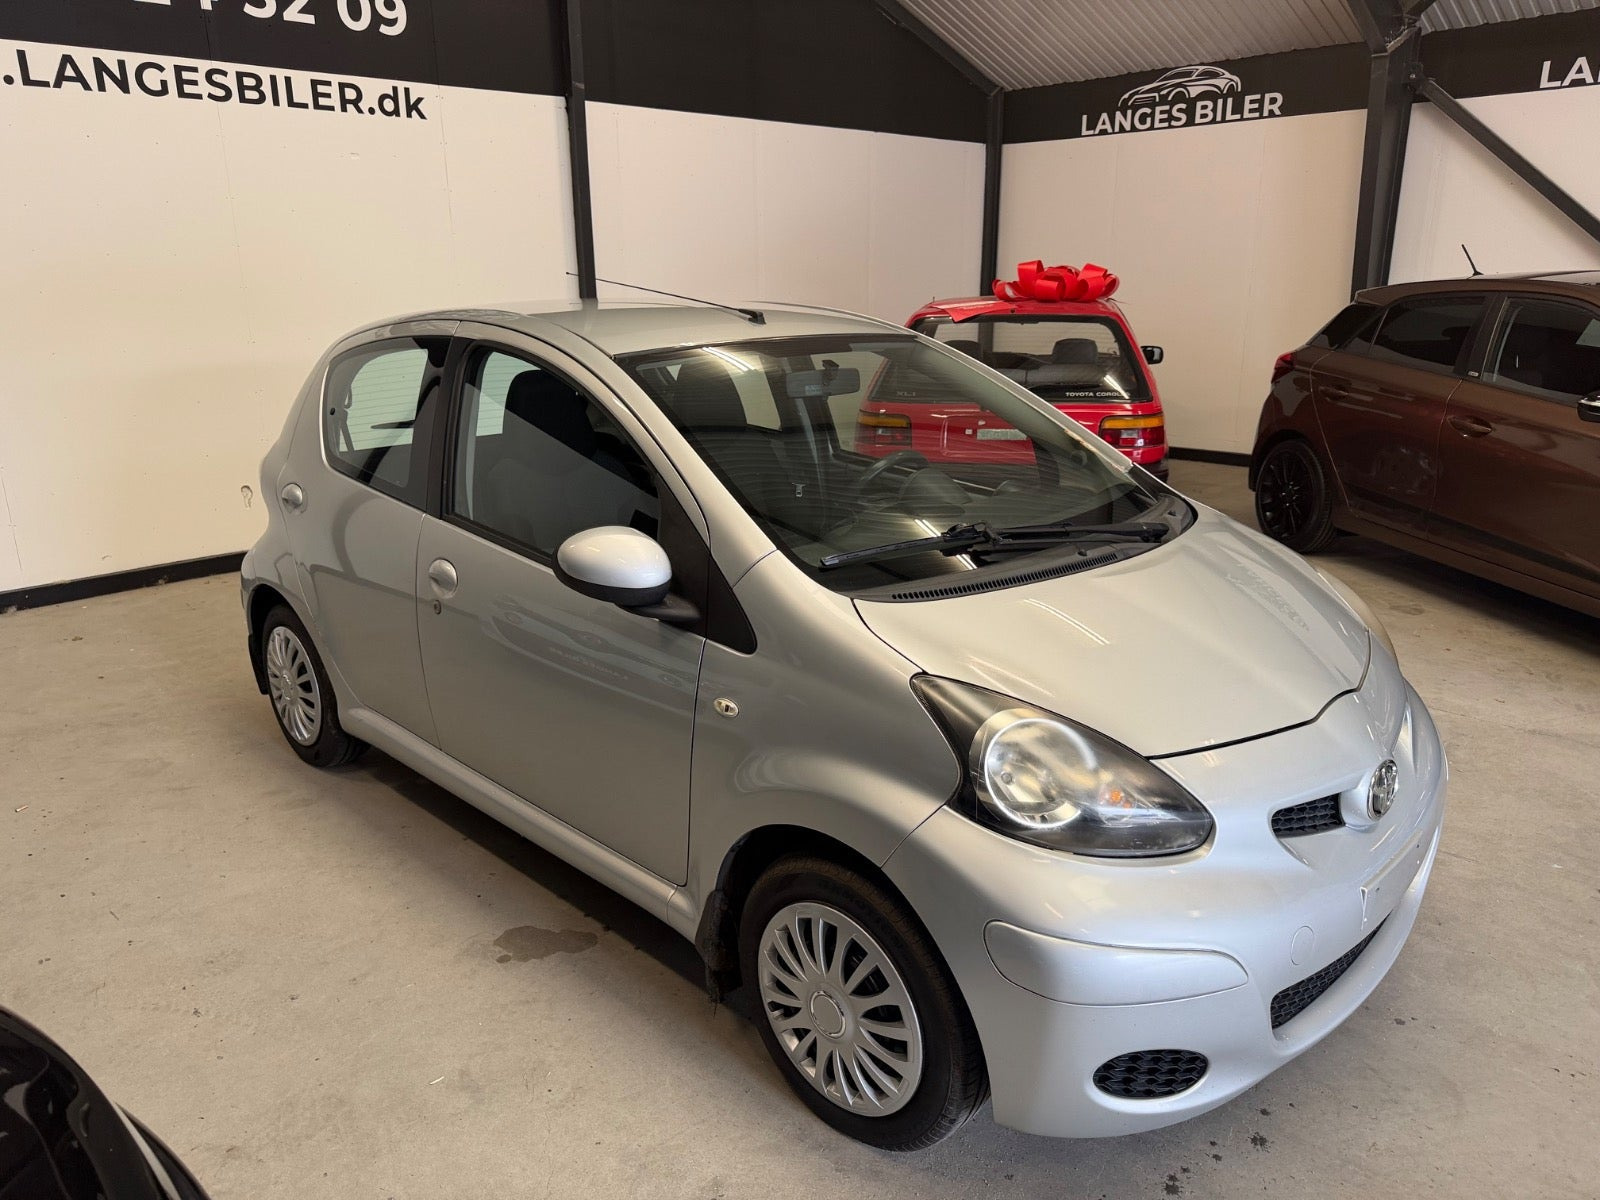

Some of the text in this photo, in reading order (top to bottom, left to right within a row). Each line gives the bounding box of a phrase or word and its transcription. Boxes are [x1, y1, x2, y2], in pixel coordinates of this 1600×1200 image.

[336, 0, 408, 37] 09
[3, 48, 428, 121] .LANGESBILER.dk
[1539, 56, 1600, 89] LA
[1080, 91, 1284, 136] LANGES BILER
